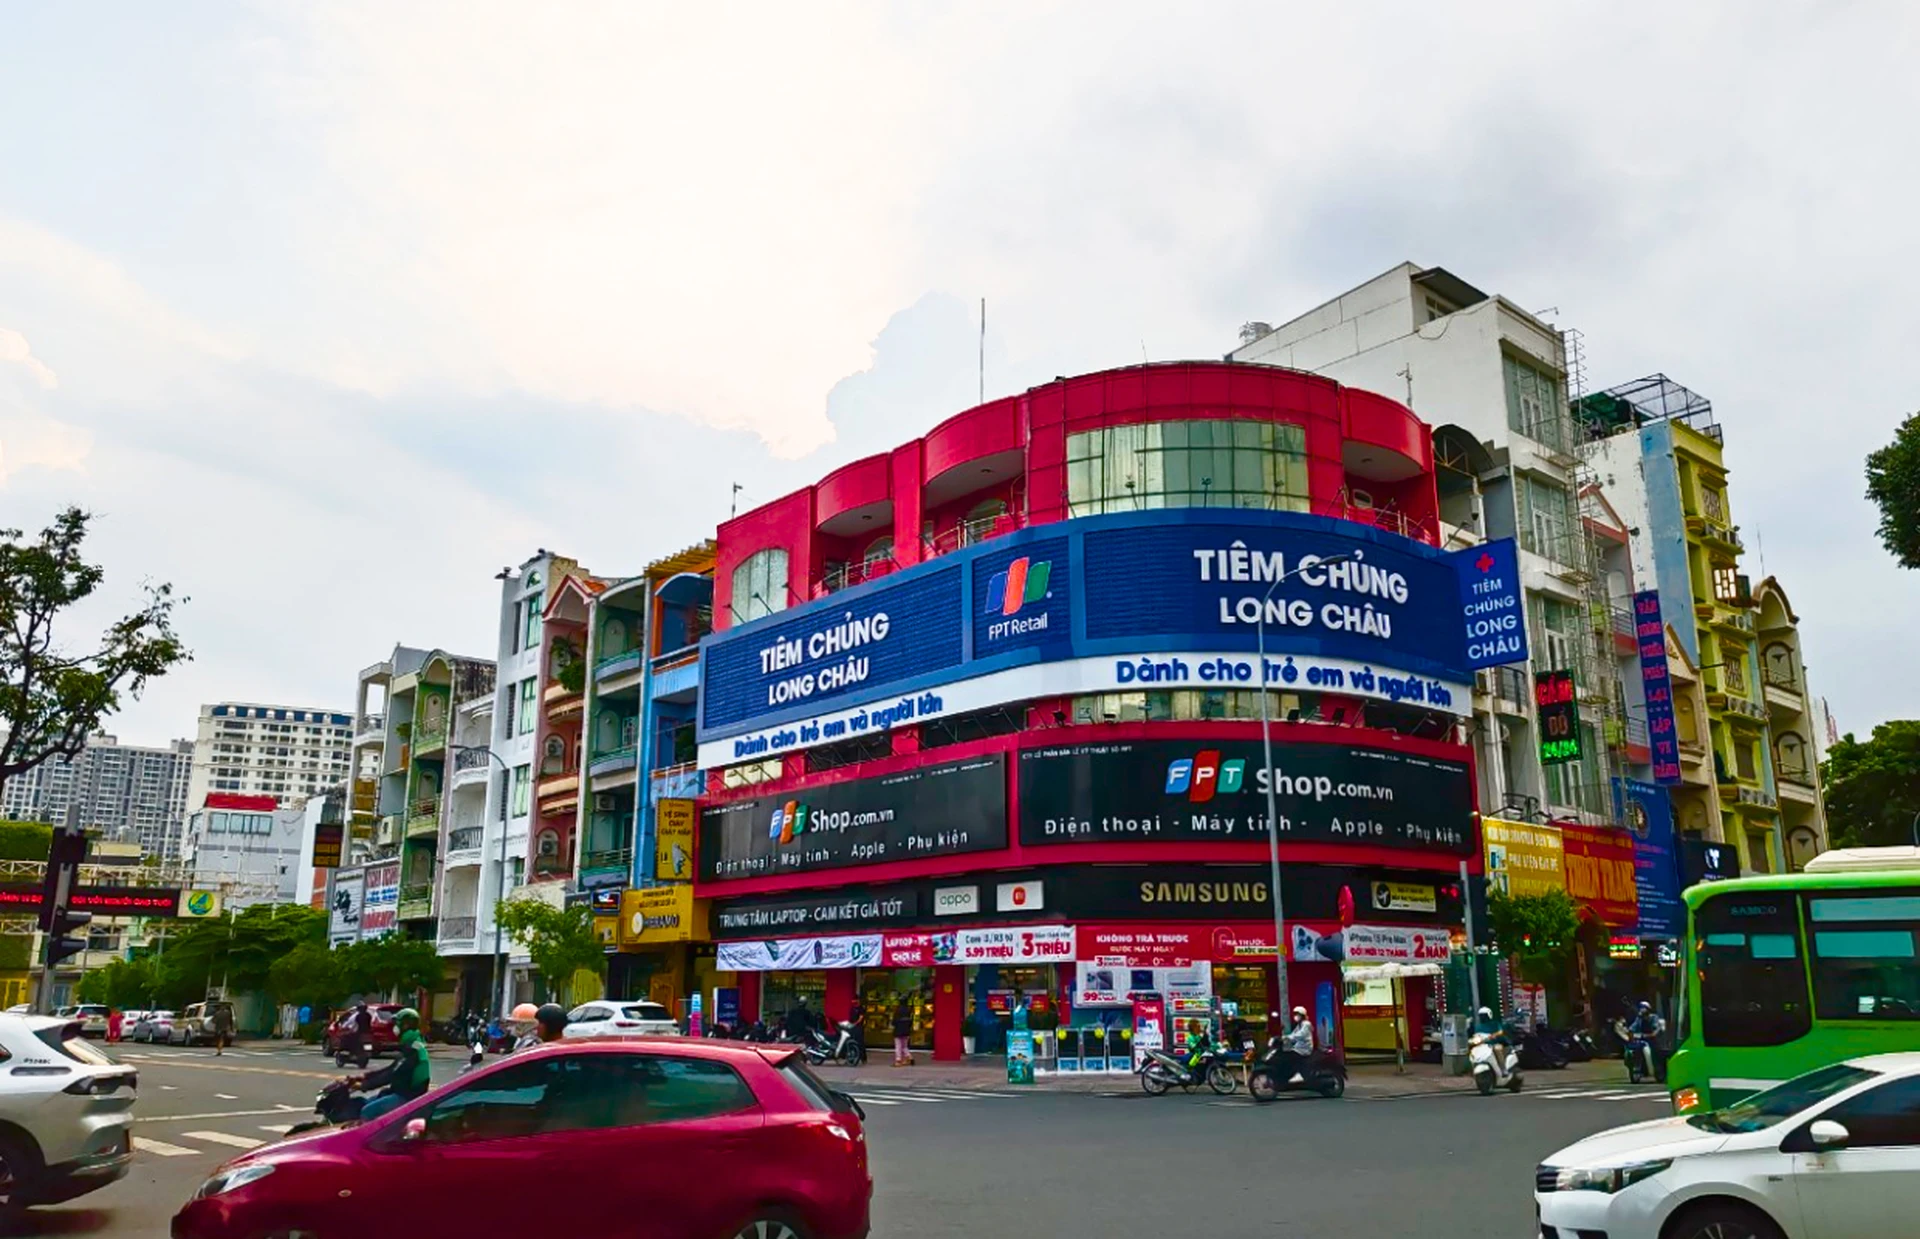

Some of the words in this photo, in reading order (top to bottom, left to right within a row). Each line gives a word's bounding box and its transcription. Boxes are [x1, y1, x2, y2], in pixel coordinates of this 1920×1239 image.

[1193, 539, 1285, 584] TIÊM
[1299, 549, 1409, 604] CHỦNG
[1472, 577, 1503, 595] TIÊM
[1464, 594, 1516, 616] CHỦNG
[988, 621, 1010, 641] FPT
[1010, 612, 1048, 635] Retail
[1219, 597, 1314, 627] LONG
[1320, 602, 1392, 639] CHÂU
[1466, 614, 1518, 638] LONG
[760, 635, 803, 675] TIÊM
[808, 611, 890, 660] CHỦNG
[1467, 634, 1521, 660] CHÂU
[769, 672, 815, 706] LONG
[818, 654, 870, 692] CHÂU
[1117, 657, 1189, 684] Dành
[1198, 658, 1252, 682] cho
[1263, 656, 1299, 683] trẻ
[1306, 667, 1344, 688] em
[1350, 665, 1375, 691] và
[1379, 673, 1424, 702] người
[1426, 680, 1452, 707] lớn
[734, 735, 768, 758] Dành
[770, 726, 797, 748] cho
[799, 719, 821, 744] trẻ
[823, 721, 845, 738] em
[849, 708, 867, 731] và
[870, 697, 915, 729] người
[917, 692, 944, 718] lớn
[1542, 738, 1578, 758] 24/24
[1045, 817, 1092, 836] Điện
[1102, 816, 1162, 836] thoại
[1191, 814, 1235, 834] Máy
[1331, 817, 1385, 837] Apple
[1407, 823, 1431, 842] Phụ
[1435, 823, 1463, 845] kiện
[741, 855, 769, 871] thoại
[781, 851, 802, 867] Máy
[806, 847, 830, 863] tính
[851, 841, 886, 859] Apple
[907, 834, 934, 852] Phụ
[938, 829, 968, 846] kiện
[1140, 881, 1269, 904] SAMSUNG
[719, 911, 749, 929] TRUNG
[749, 908, 770, 927] TÂM
[770, 905, 808, 923] LAPTOP
[814, 903, 837, 921] CAM
[838, 900, 860, 920] KẾT
[859, 898, 881, 918] GIÁ
[881, 899, 903, 916] TỐT
[1021, 932, 1034, 957] 3
[1035, 939, 1071, 957] TRIỆU
[1096, 933, 1133, 943] KHÔNG
[1135, 932, 1155, 943] TRẢ
[1350, 932, 1373, 943] iPhone
[1382, 934, 1393, 944] Pro
[1413, 934, 1425, 959] 2
[965, 946, 985, 958] 5.99
[985, 944, 1014, 958] TRIỆU
[1377, 949, 1384, 957] 12
[1425, 942, 1449, 959] NĂM
